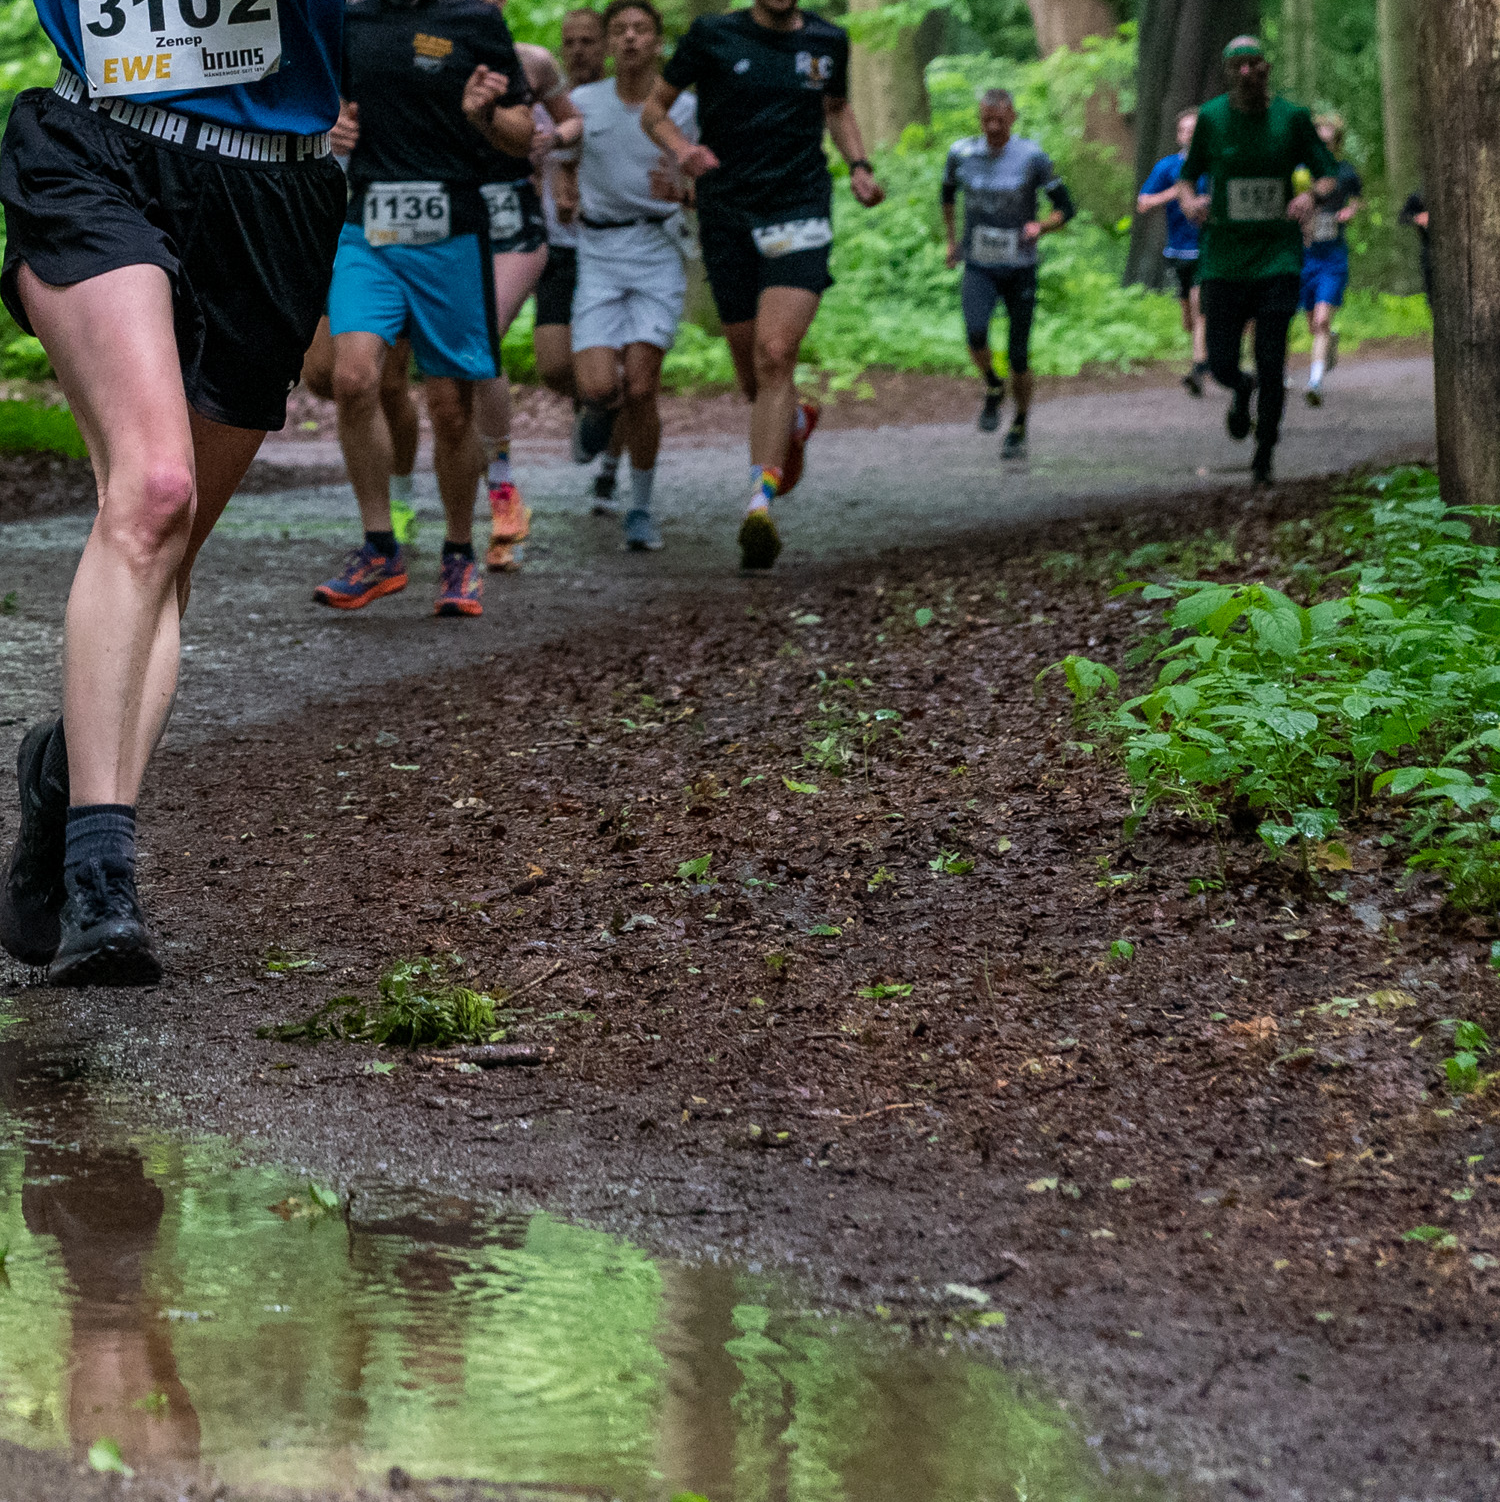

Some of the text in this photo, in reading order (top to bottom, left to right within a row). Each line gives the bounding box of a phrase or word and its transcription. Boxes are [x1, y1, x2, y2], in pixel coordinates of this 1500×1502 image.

[156, 35, 203, 48] Zenep
[103, 47, 264, 84] EWE bruns
[89, 97, 189, 144] PUMA
[196, 122, 287, 162] PUMA
[369, 196, 444, 220] 1136
